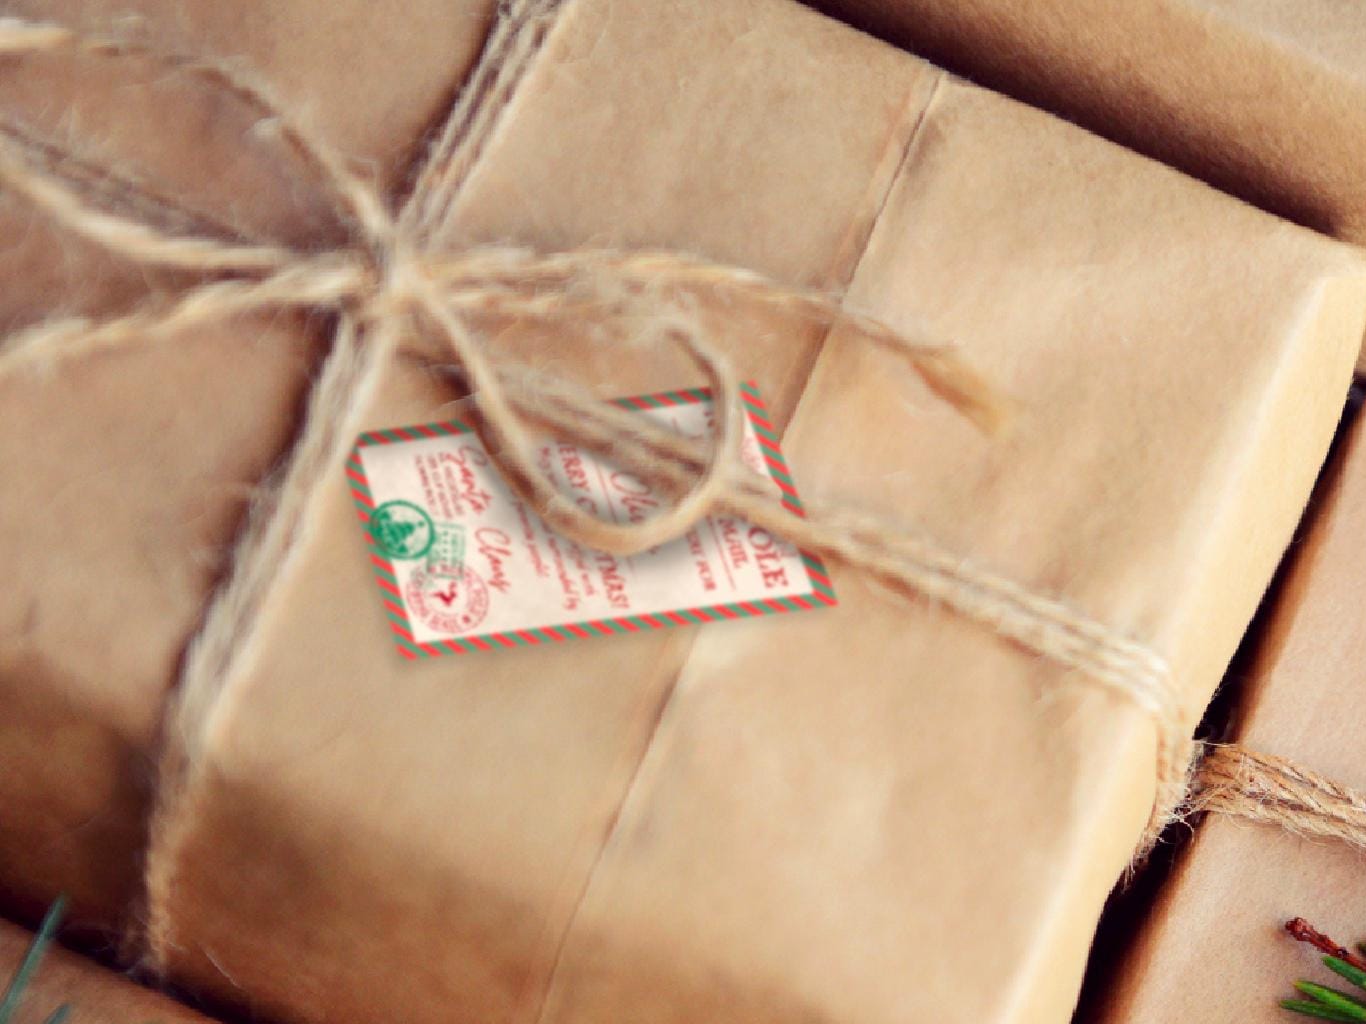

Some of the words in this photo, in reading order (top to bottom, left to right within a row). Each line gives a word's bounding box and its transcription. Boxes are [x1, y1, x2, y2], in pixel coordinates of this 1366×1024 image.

[443, 446, 493, 515] Santa
[475, 527, 512, 594] Claus
[746, 524, 789, 587] OLE
